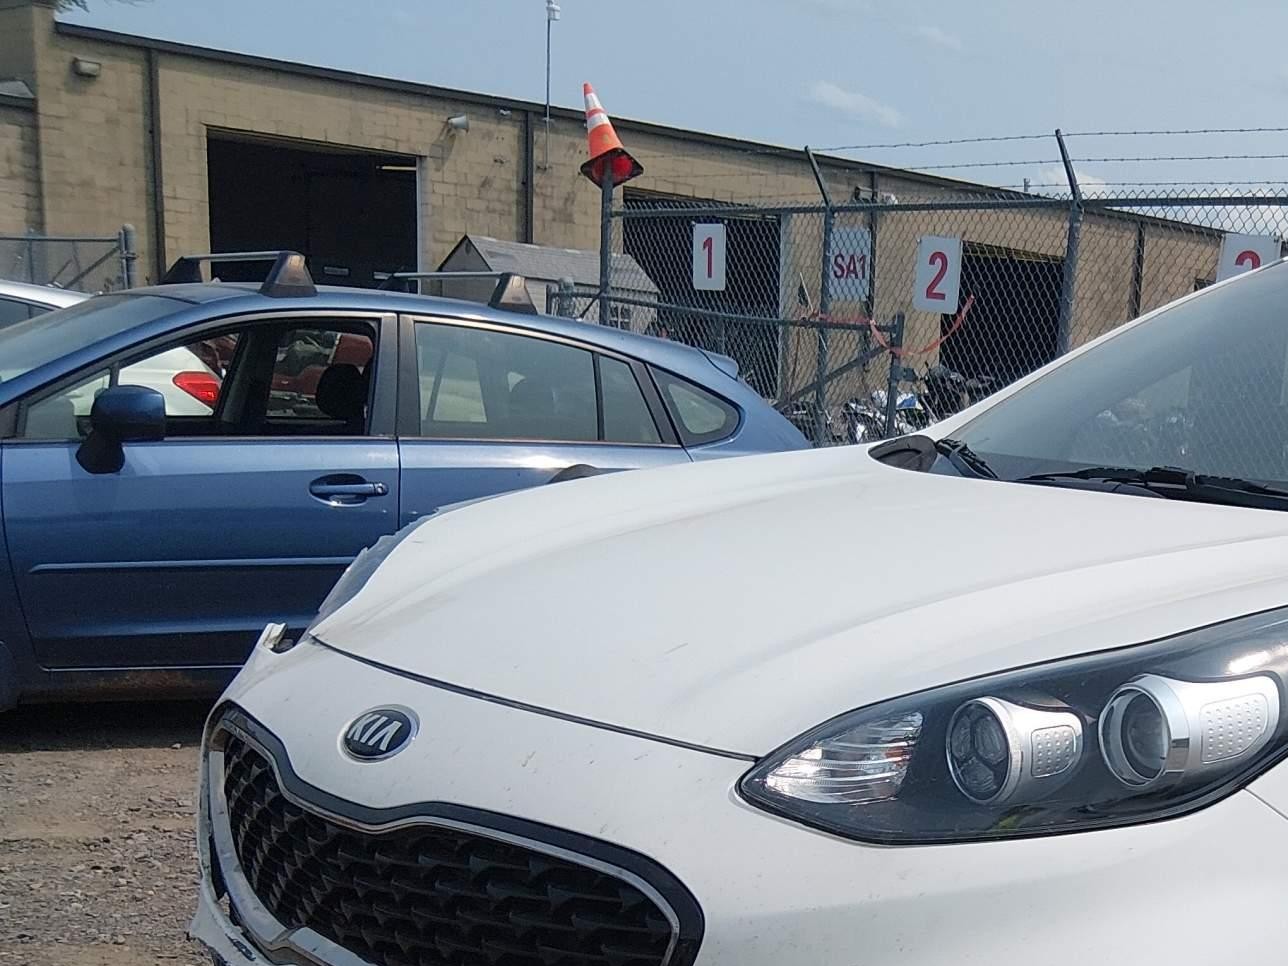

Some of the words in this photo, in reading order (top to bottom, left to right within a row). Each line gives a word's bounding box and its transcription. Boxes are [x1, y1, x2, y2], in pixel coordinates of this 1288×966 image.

[702, 236, 713, 280] 1
[833, 254, 867, 280] SA1
[925, 251, 948, 301] 2
[347, 712, 403, 752] KIA
